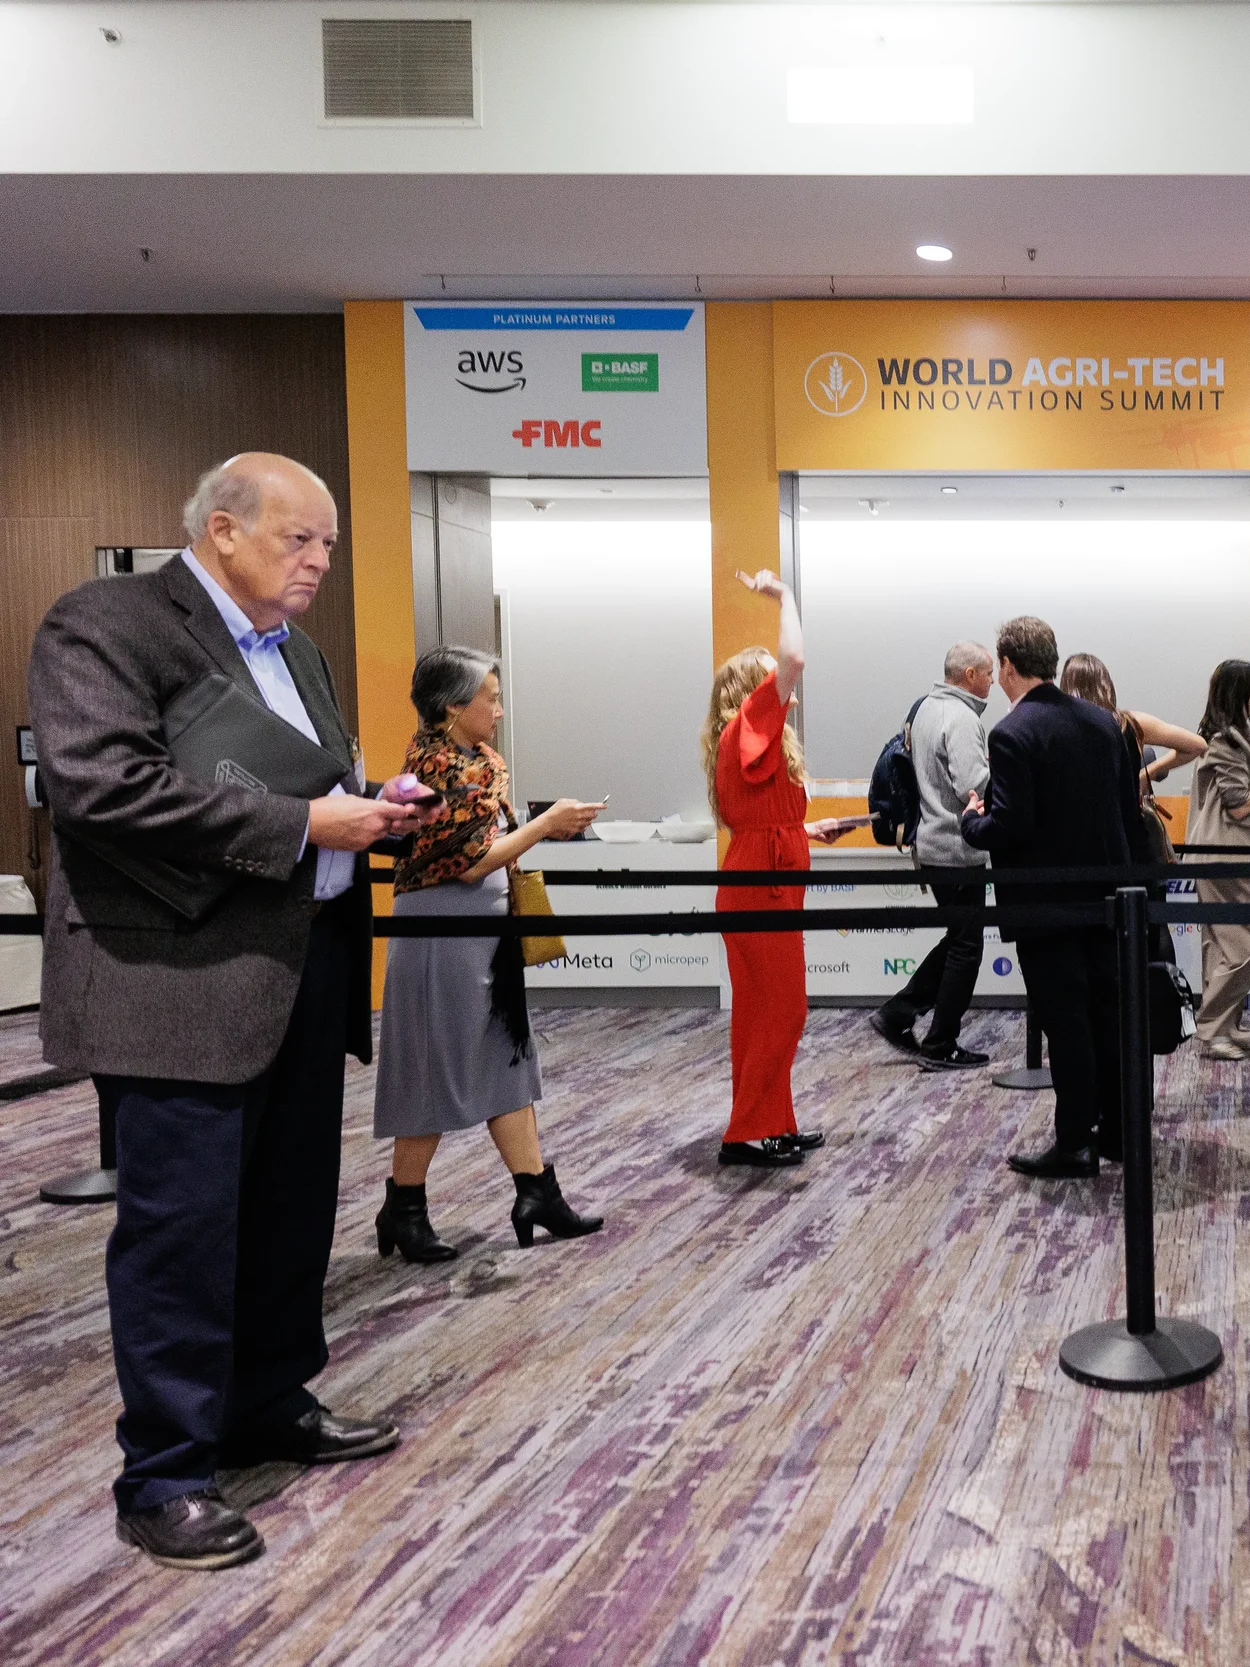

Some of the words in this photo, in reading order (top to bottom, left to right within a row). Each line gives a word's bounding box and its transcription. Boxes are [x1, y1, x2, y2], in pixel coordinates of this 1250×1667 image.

[493, 314, 552, 325] PLATINUM
[555, 314, 616, 325] PARTNERS
[457, 350, 523, 374] aws
[611, 361, 648, 374] BASF
[878, 357, 1013, 387] WORLD
[1021, 357, 1225, 387] AGRI-TECH
[880, 390, 1082, 411] INNOVATION
[1100, 390, 1225, 411] SUMMIT
[512, 420, 602, 448] FMC
[564, 953, 613, 969] Meta
[654, 954, 709, 966] micropep
[805, 961, 851, 974] crosoft
[884, 958, 917, 976] NPC
